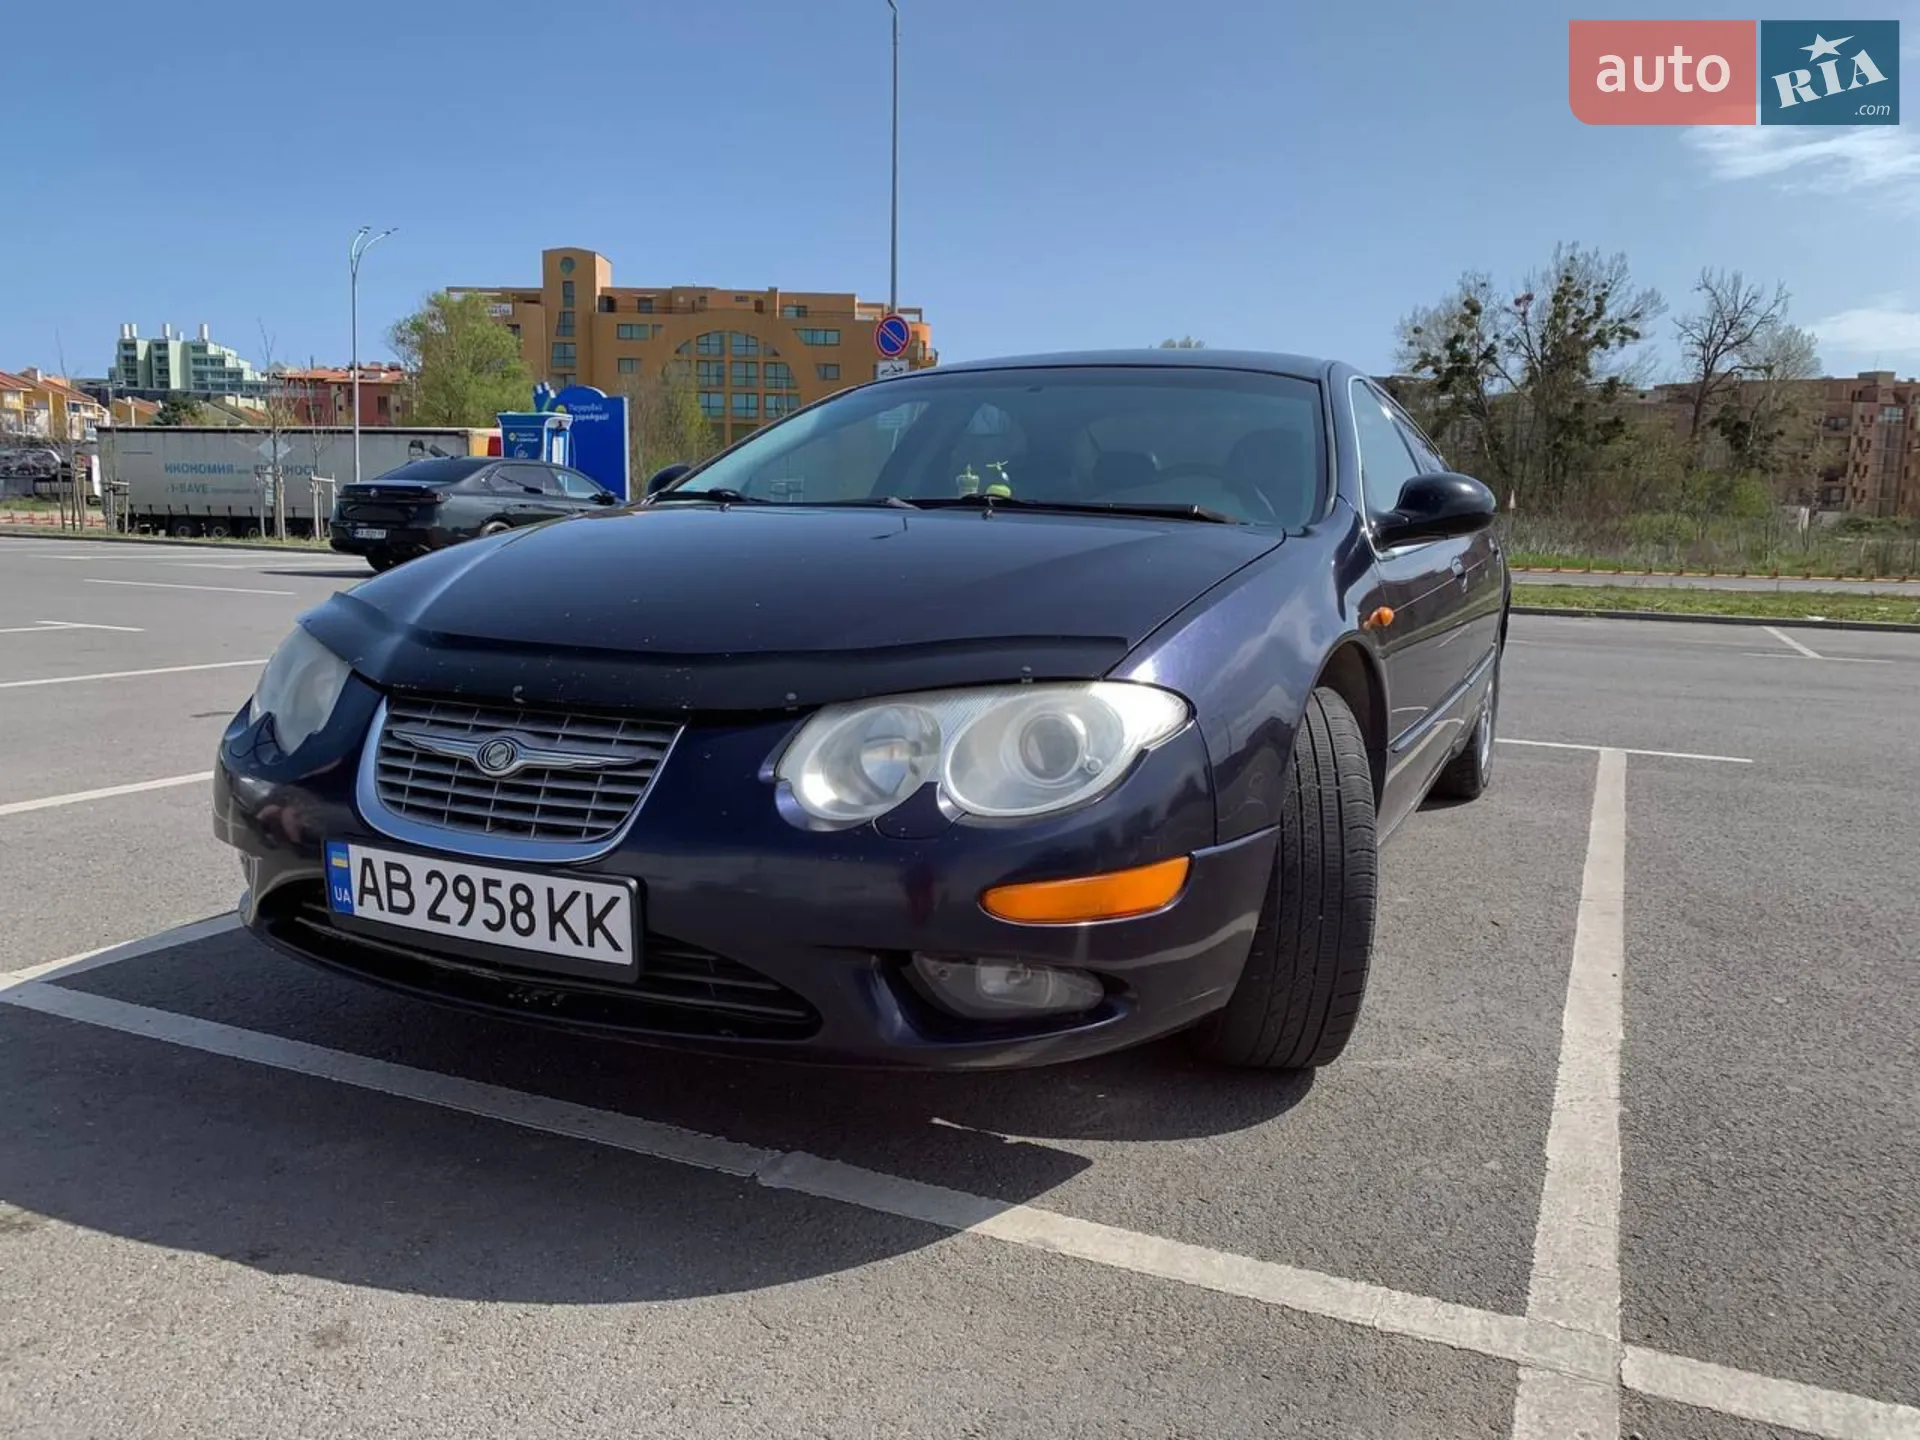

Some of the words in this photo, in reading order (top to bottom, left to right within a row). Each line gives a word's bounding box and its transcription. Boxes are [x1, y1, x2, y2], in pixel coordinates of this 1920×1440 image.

[165, 463, 235, 475] ИКОНОМИЯ
[334, 886, 351, 904] UA
[358, 857, 415, 915] AB
[425, 870, 536, 937] 2958
[547, 887, 623, 952] KK
